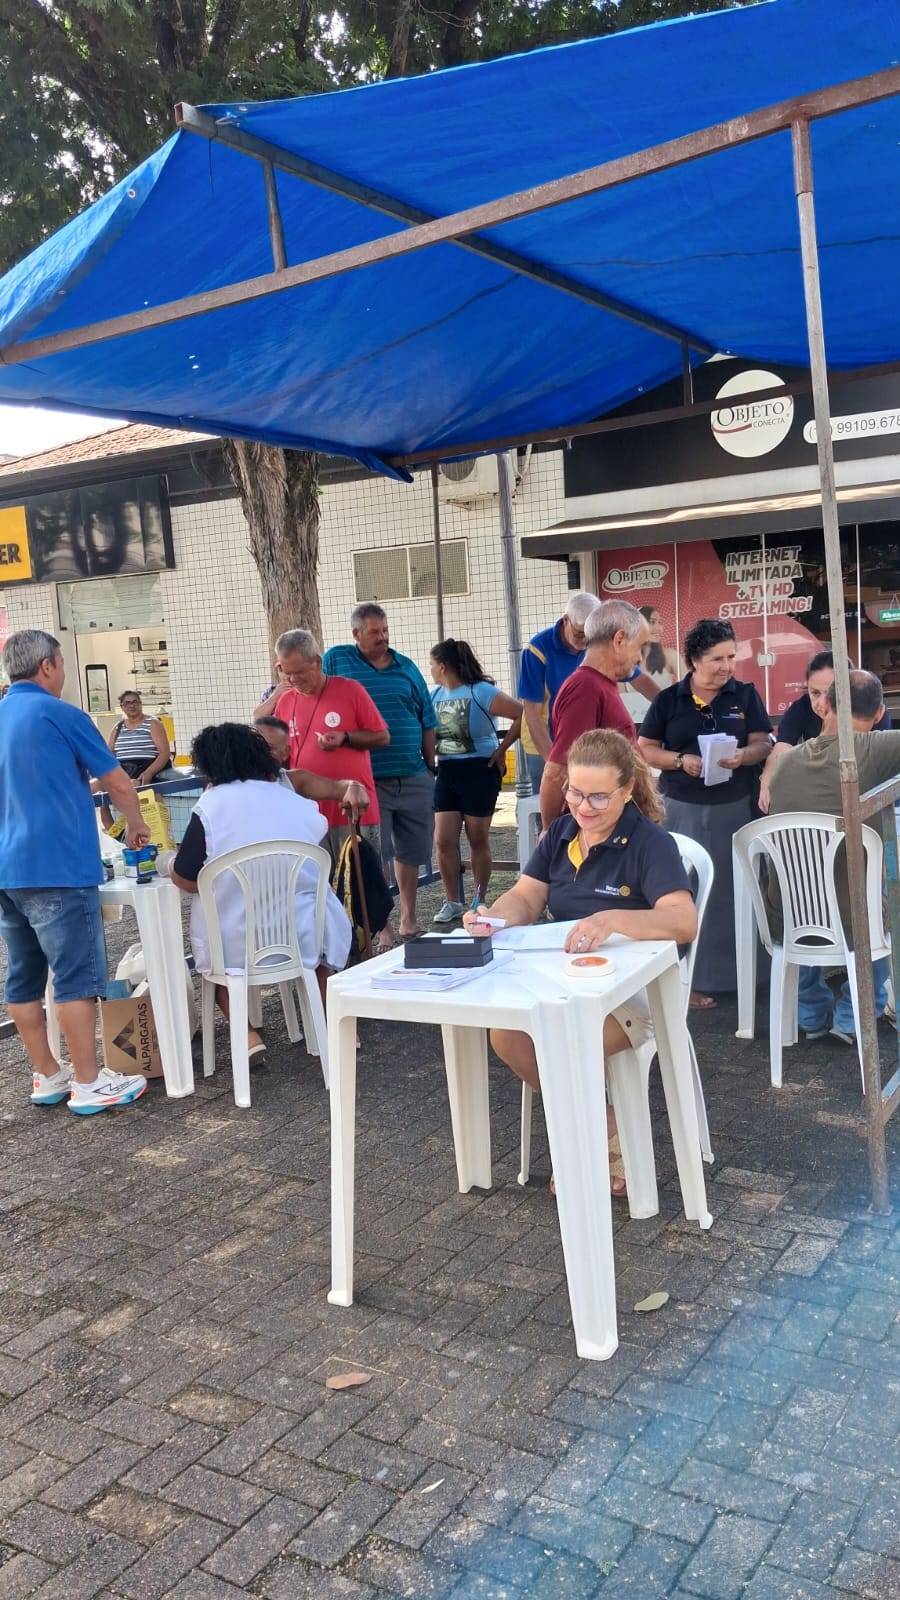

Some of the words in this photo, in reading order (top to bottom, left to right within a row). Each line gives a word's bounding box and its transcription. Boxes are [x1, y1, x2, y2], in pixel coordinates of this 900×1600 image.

[717, 402, 785, 426] OBJETO
[753, 417, 785, 428] CONECTA
[727, 547, 801, 567] INTERNET
[608, 569, 661, 585] OBJETO
[728, 564, 801, 584] ILIMITADA
[749, 583, 770, 598] TV
[772, 581, 793, 596] HD
[721, 596, 812, 618] STREAMING!
[138, 1002, 153, 1072] ALPARGATAS
